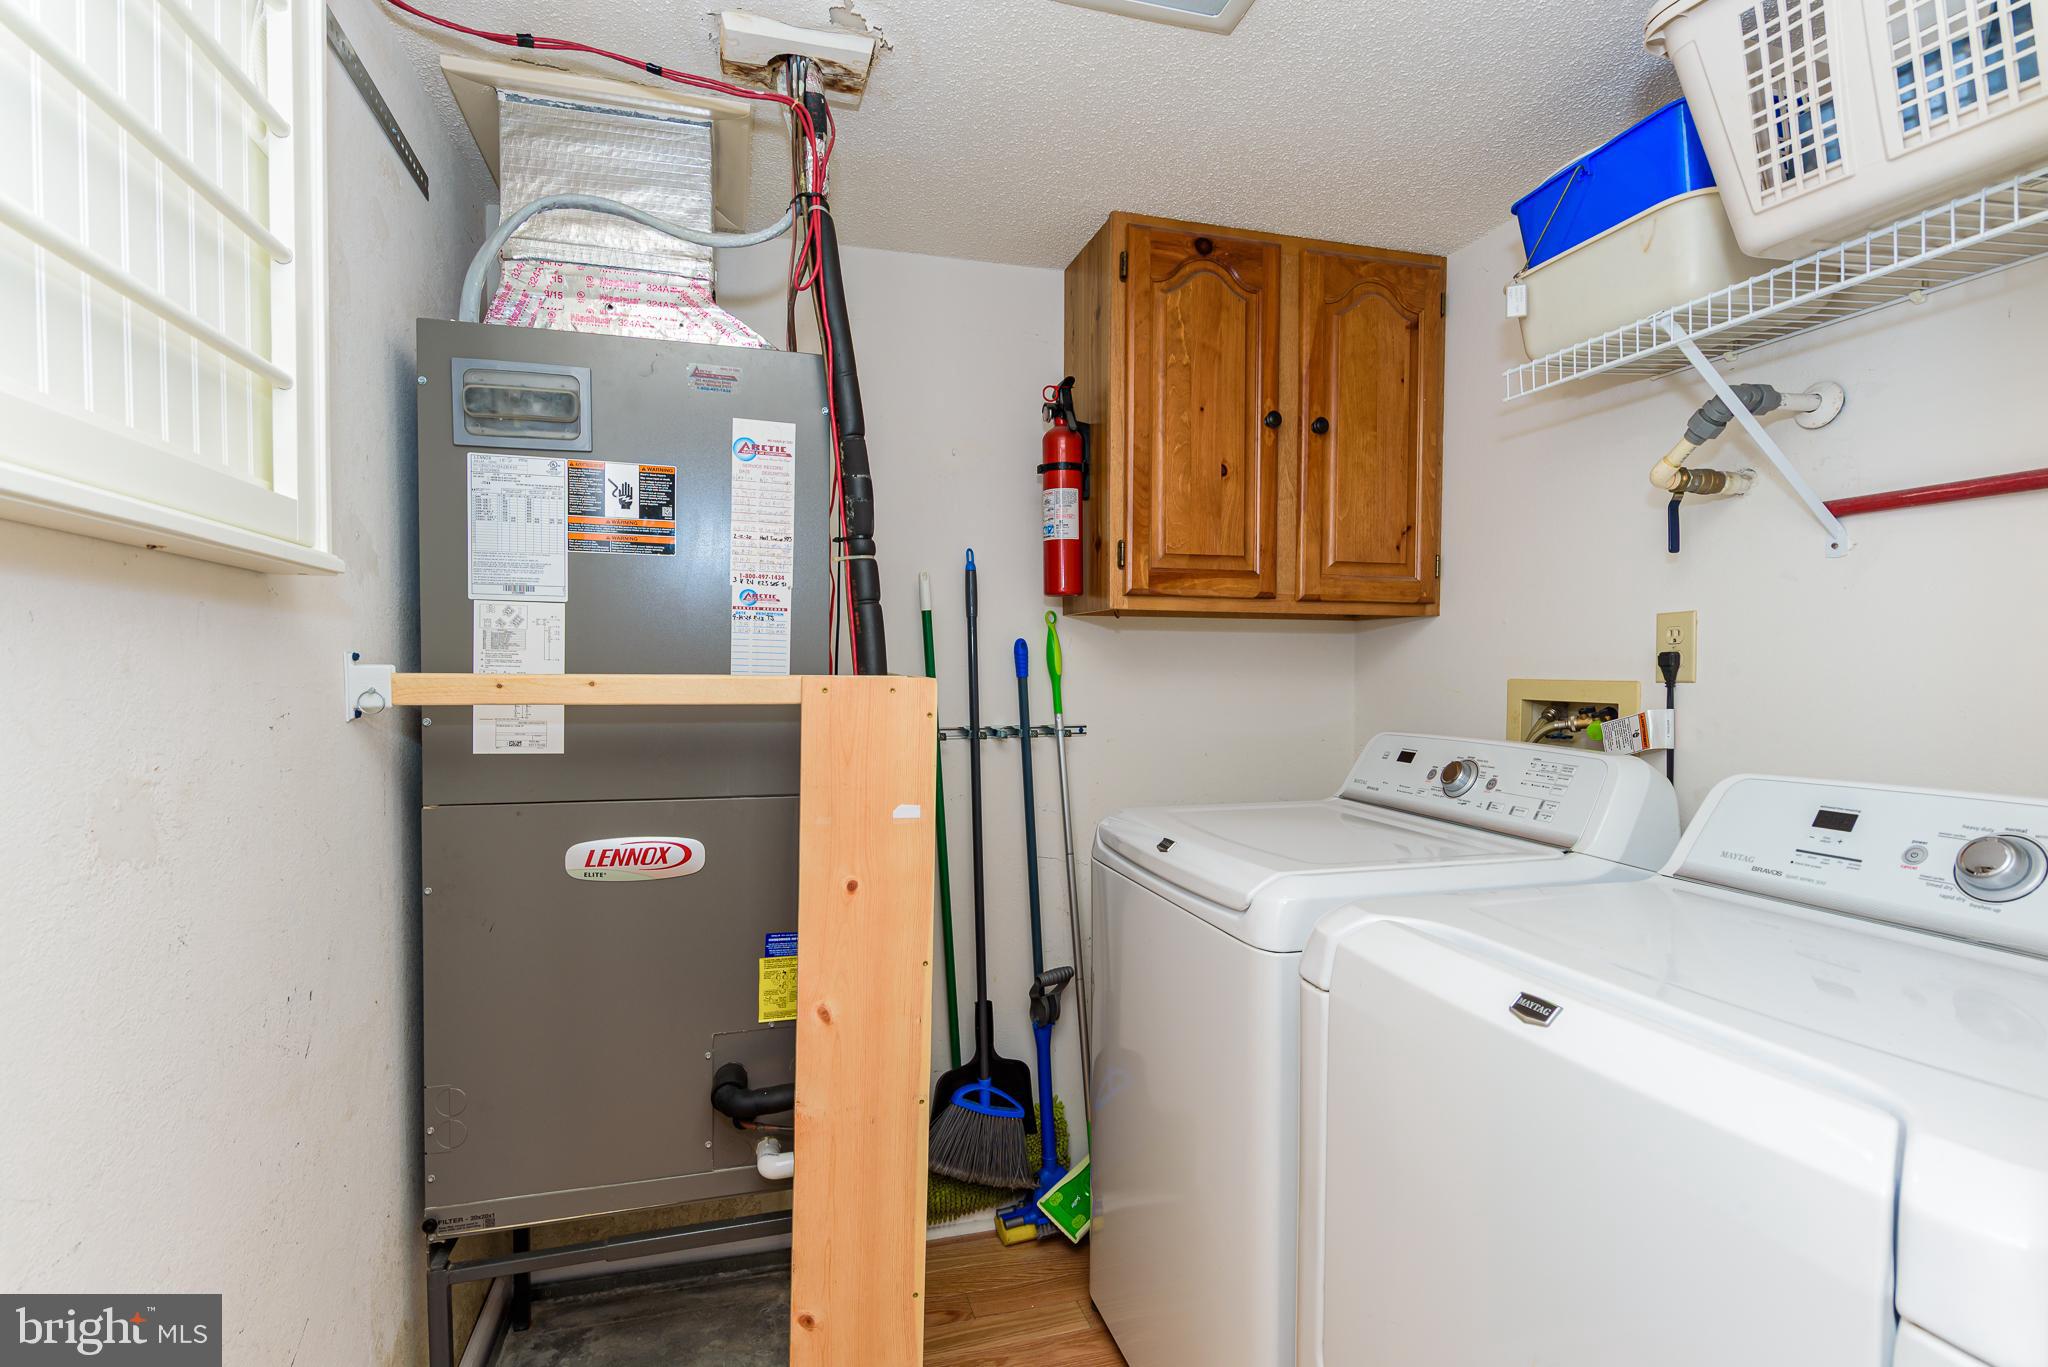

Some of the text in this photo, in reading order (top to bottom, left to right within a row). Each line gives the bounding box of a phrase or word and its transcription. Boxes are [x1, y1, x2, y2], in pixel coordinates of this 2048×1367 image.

[738, 442, 787, 454] ARCTIC
[584, 846, 671, 868] LENNOX
[1720, 850, 1756, 864] MAYTAG
[1751, 866, 1783, 877] BRAVOS
[1518, 997, 1552, 1016] MAYTAG
[438, 1217, 464, 1225] FILTER
